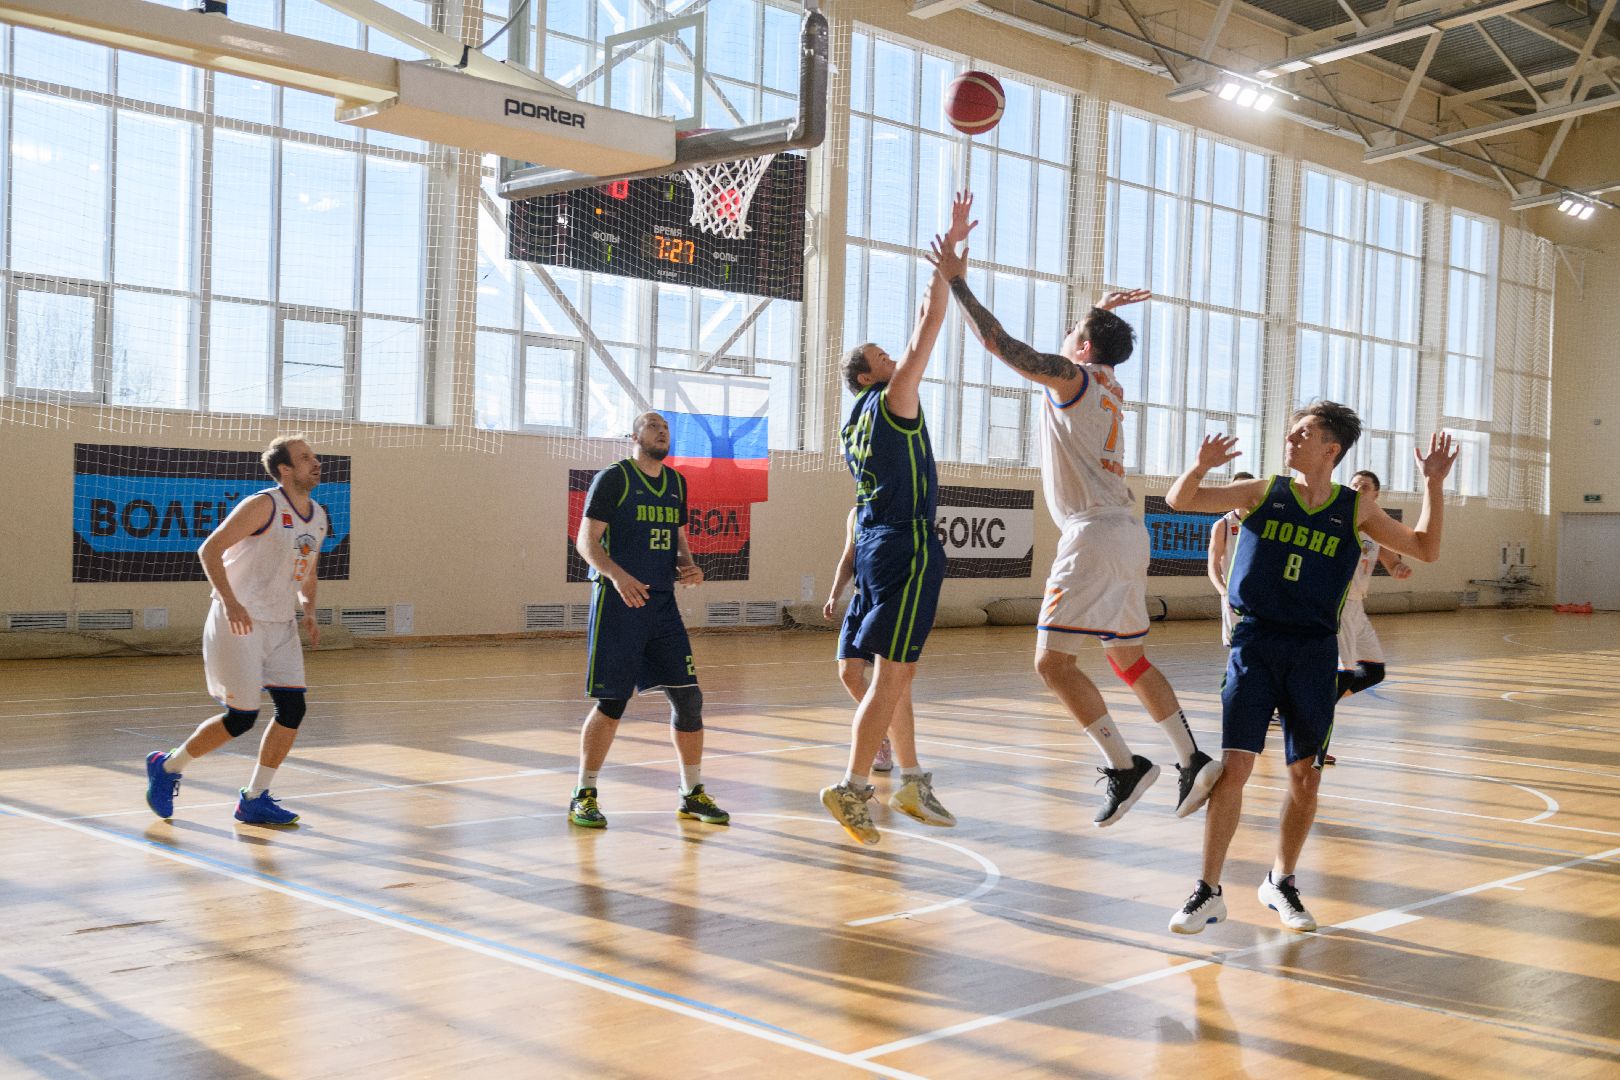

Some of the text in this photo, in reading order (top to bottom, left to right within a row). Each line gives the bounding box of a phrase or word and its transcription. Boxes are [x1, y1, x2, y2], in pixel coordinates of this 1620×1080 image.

[592, 230, 620, 244] ФОЛЫ
[653, 224, 683, 238] ВРЕМЯ
[654, 235, 695, 265] 7:27
[712, 251, 738, 263] ФОЛЫ
[1101, 395, 1119, 453] 7
[688, 508, 740, 537] БОЛ
[650, 528, 671, 550] 23
[1261, 519, 1341, 558] ЛОБНЯ
[1283, 553, 1304, 582] 8
